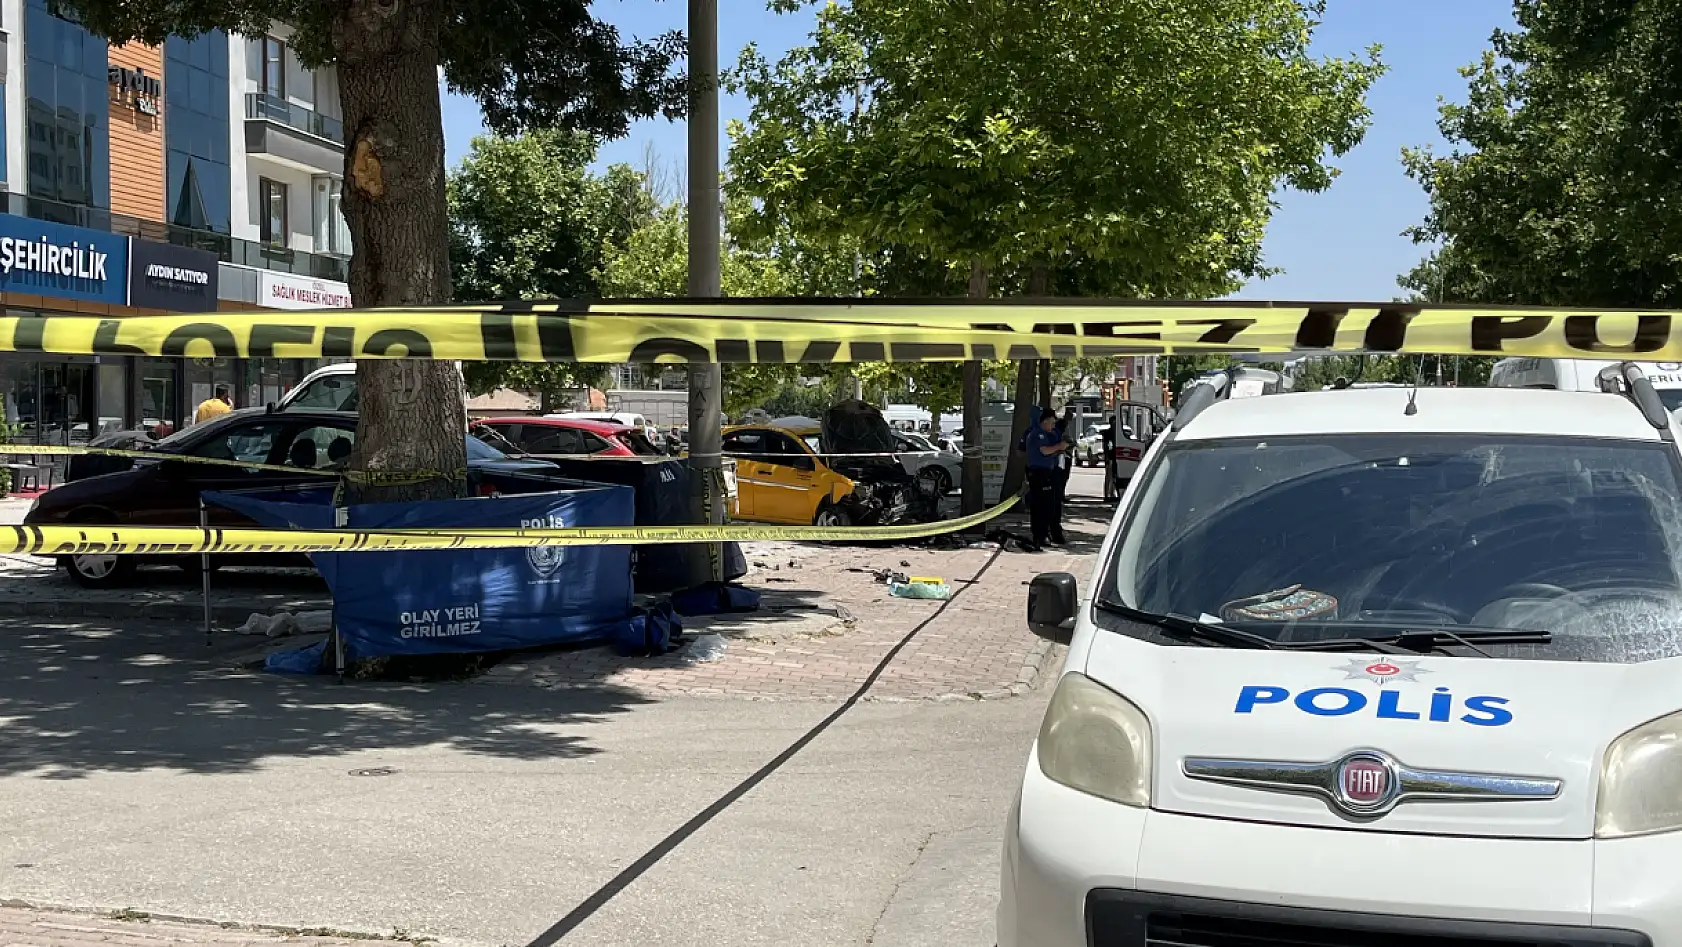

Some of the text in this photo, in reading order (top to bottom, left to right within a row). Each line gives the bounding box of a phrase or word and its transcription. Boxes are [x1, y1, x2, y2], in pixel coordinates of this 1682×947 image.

[0, 235, 108, 281] ŞEHİRCİLİK
[401, 602, 479, 625] OLAY YERİ
[401, 621, 481, 639] GİRİLMEZ
[1234, 685, 1514, 727] POLİS
[1349, 768, 1383, 794] FIAT
